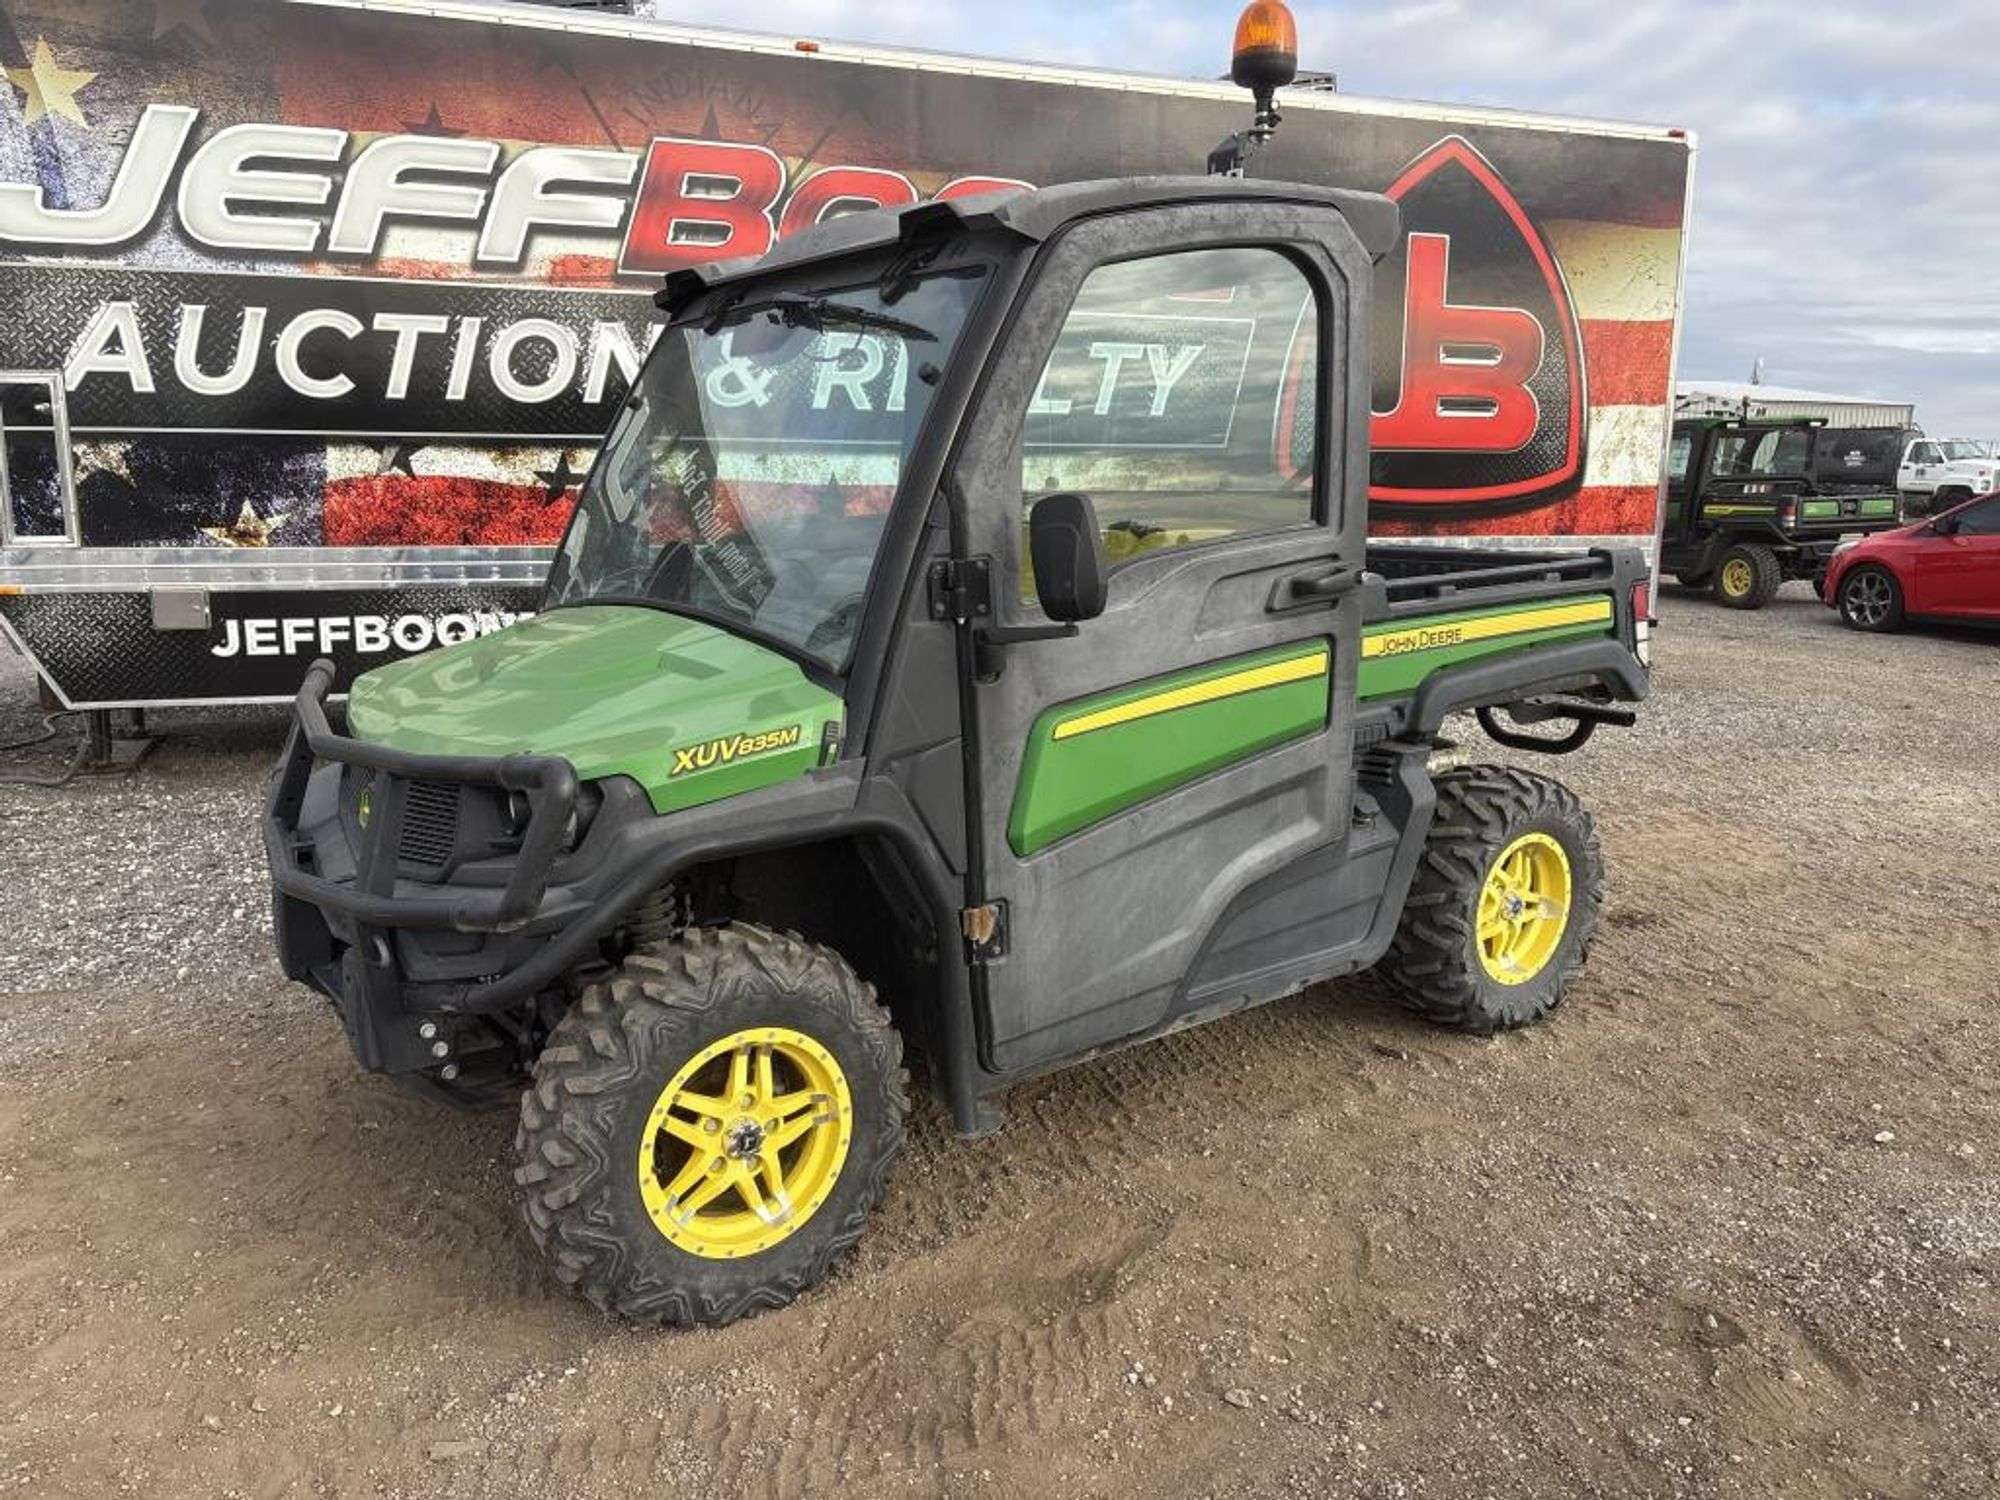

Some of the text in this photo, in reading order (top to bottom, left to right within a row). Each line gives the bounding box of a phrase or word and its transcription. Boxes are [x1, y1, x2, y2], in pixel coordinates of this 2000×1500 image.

[66, 301, 668, 404] AUCTION
[705, 332, 781, 408] &
[1379, 628, 1463, 654] JOHN DEERE
